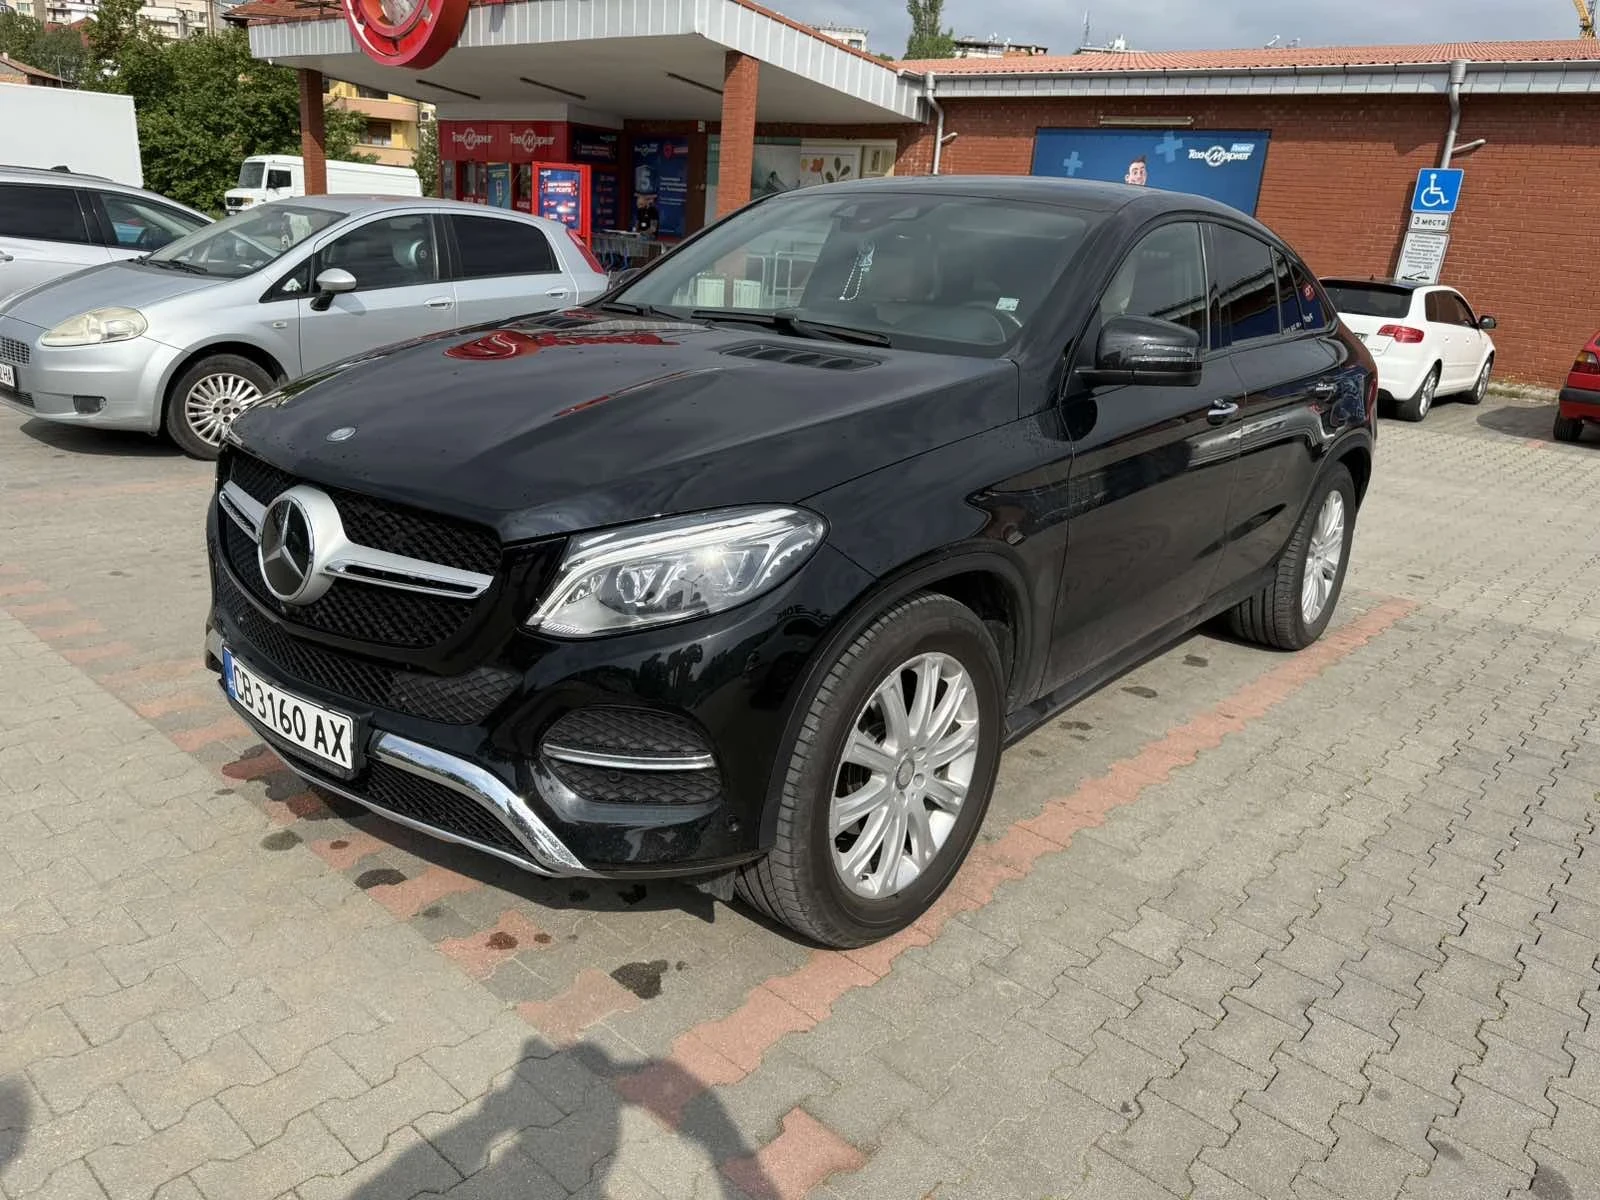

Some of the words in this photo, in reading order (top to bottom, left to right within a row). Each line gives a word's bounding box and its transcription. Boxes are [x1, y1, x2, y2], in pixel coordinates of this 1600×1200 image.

[1414, 216, 1421, 225] 3
[255, 684, 306, 742] 3160
[314, 714, 347, 763] AX
